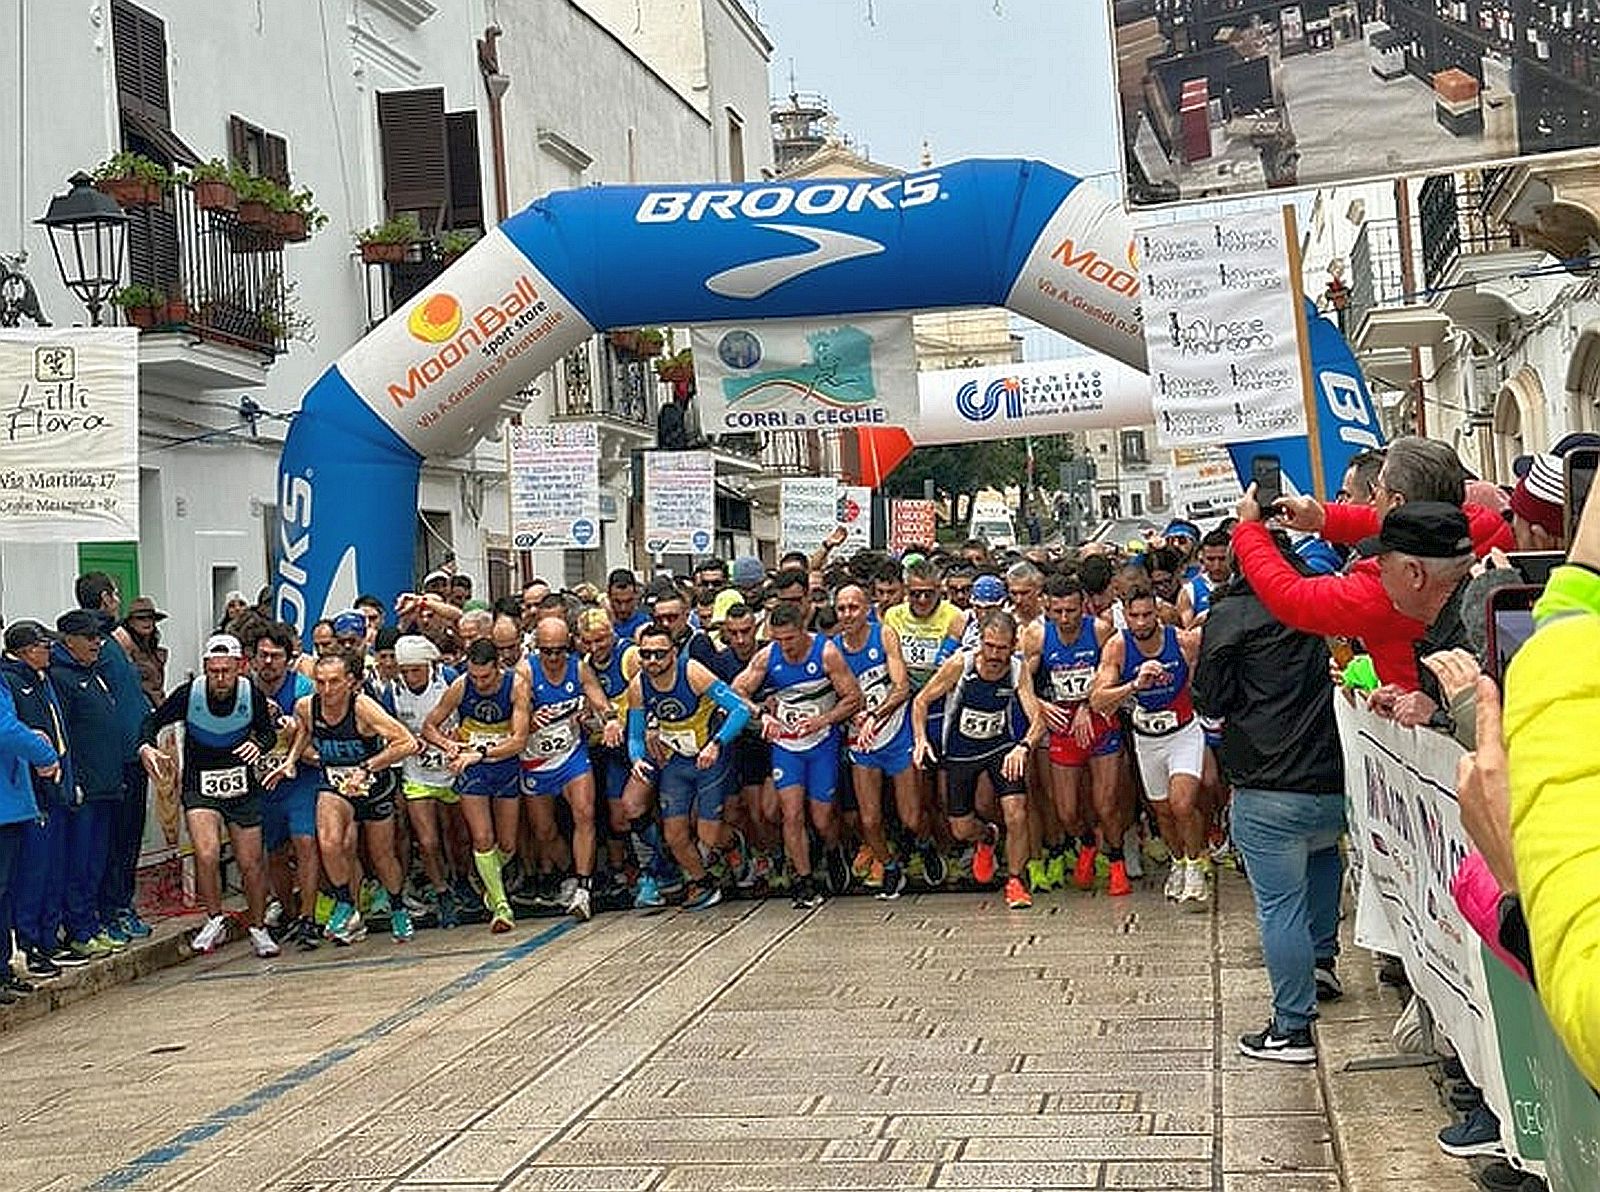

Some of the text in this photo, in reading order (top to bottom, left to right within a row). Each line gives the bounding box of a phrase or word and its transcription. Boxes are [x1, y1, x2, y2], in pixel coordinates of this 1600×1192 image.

[635, 173, 942, 223] BROOKS
[481, 300, 548, 358] sport store
[1021, 379, 1102, 395] SPORTIVO
[1022, 388, 1103, 405] ITALIANO
[7, 410, 115, 441] Flora
[725, 407, 885, 428] CORRI a CEGLIE
[204, 774, 246, 795] 363
